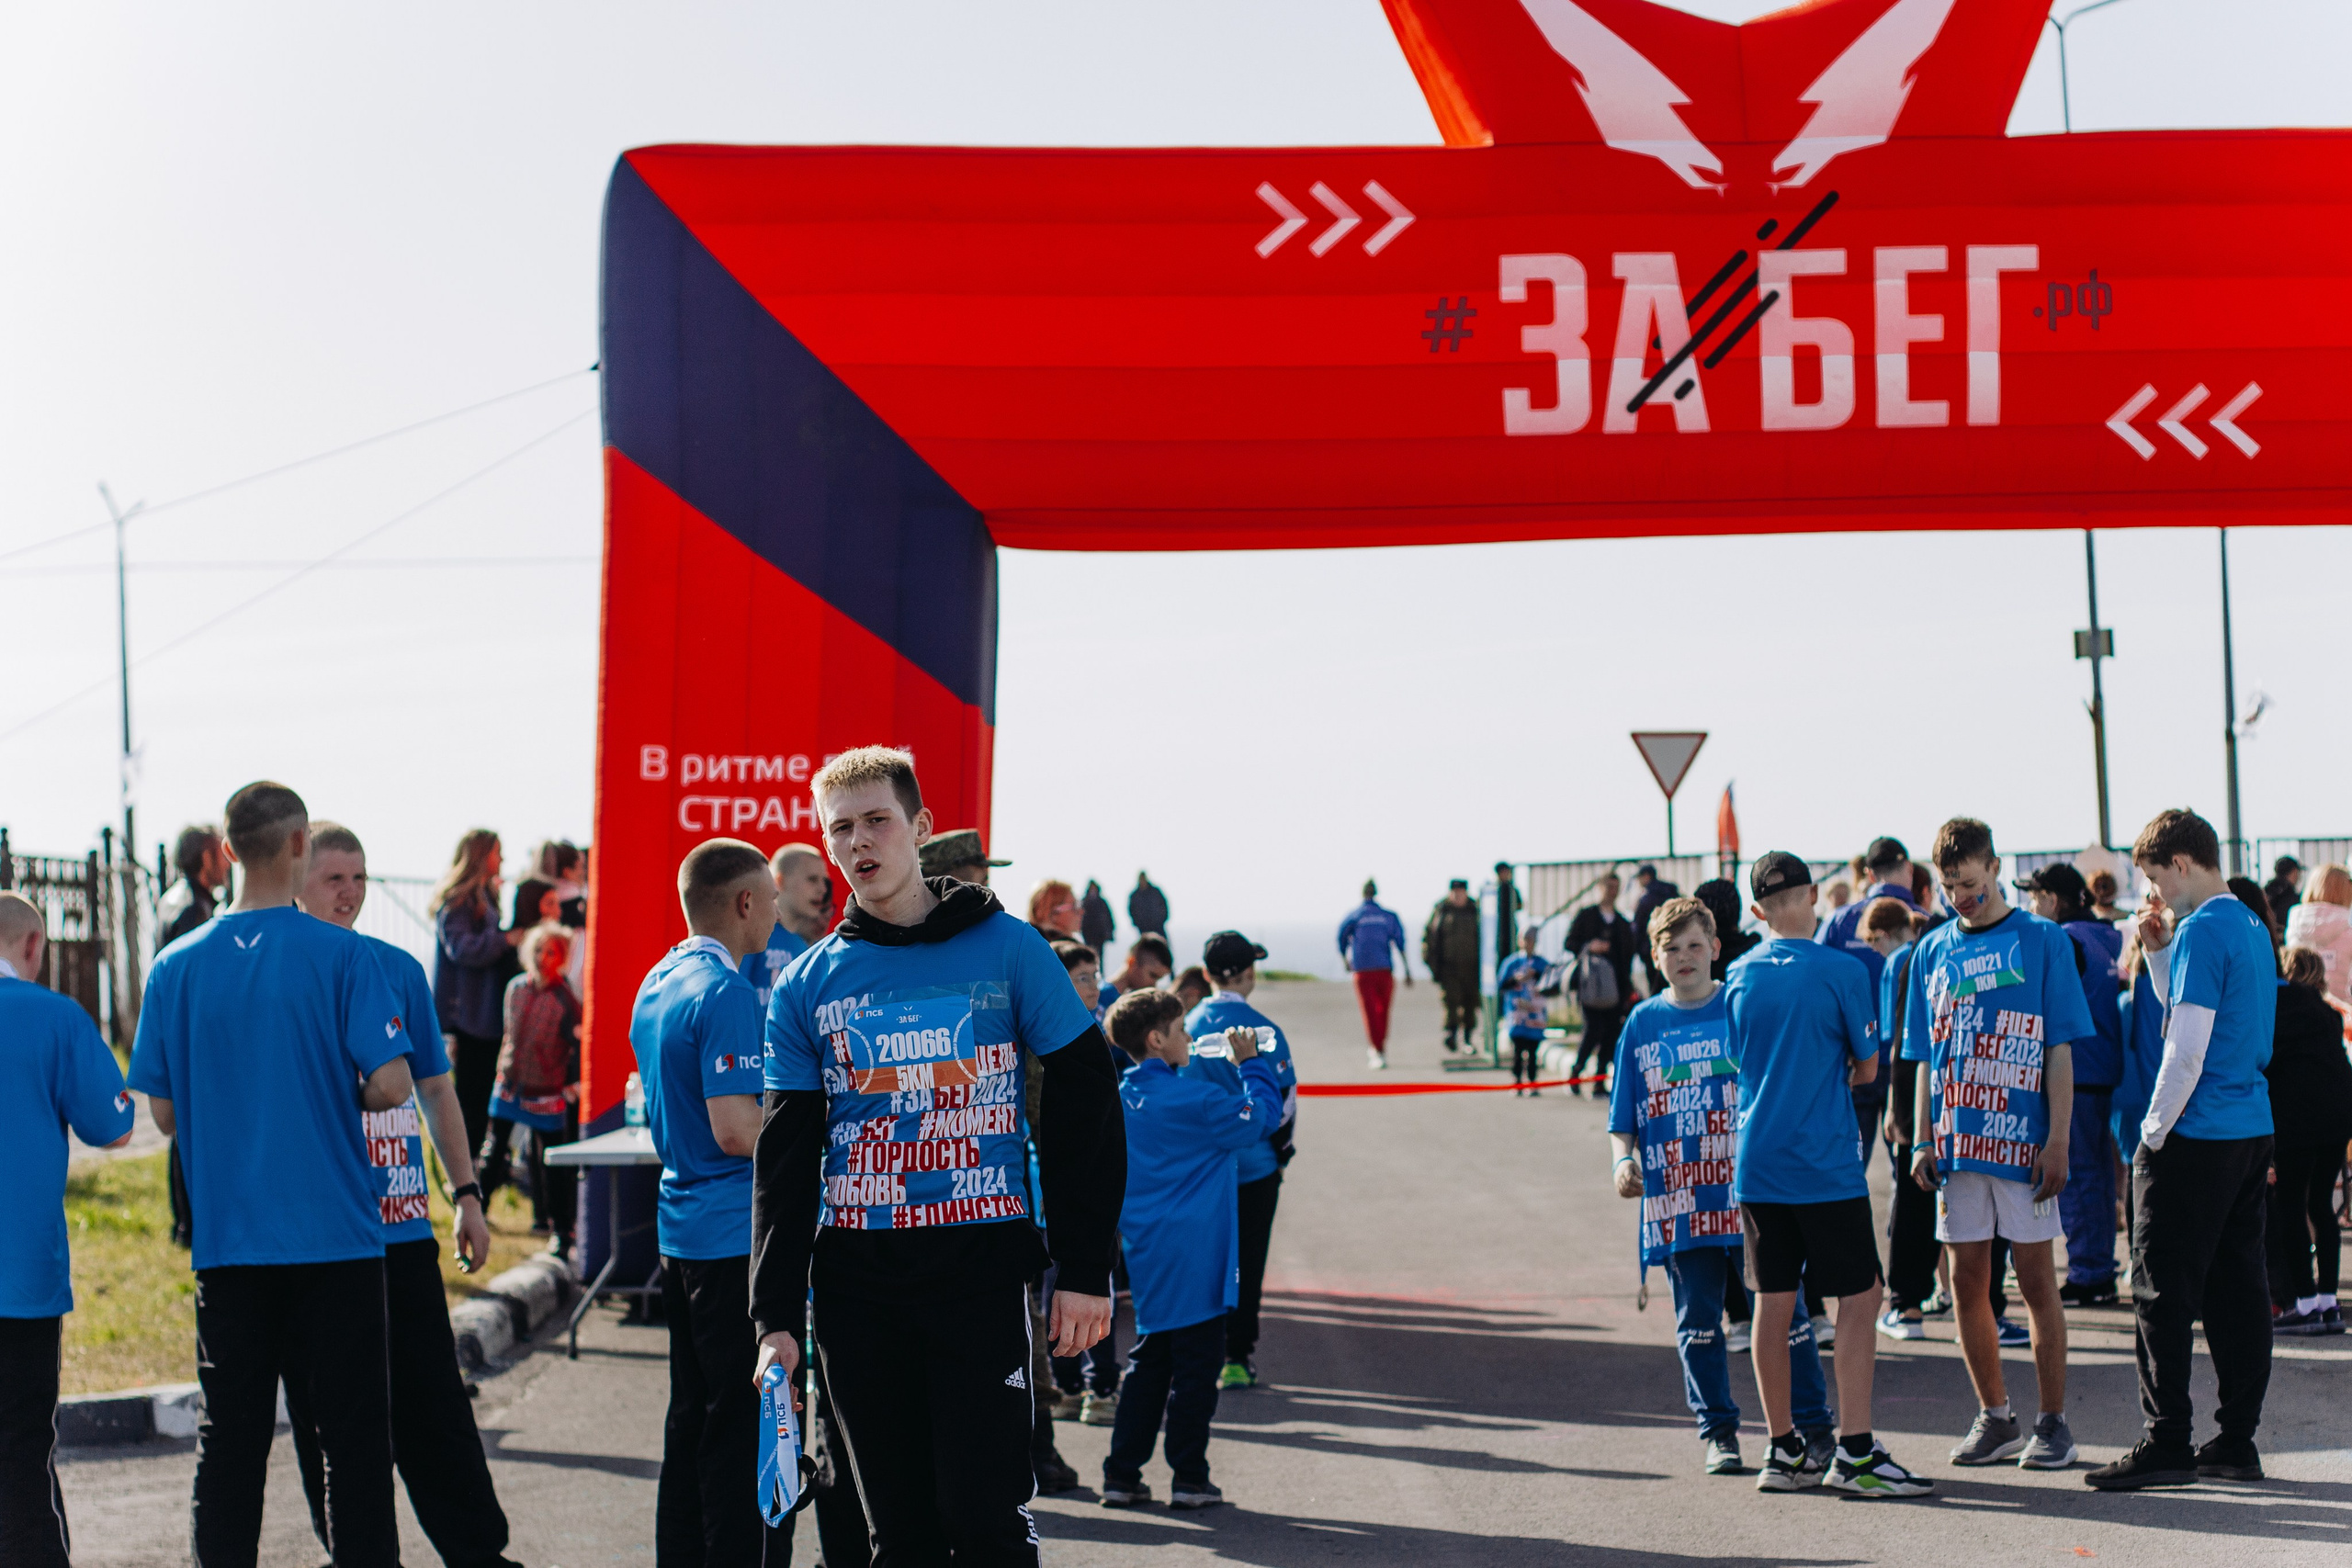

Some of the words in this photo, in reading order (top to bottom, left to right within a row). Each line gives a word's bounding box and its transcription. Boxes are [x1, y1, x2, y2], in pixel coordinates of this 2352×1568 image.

[639, 745, 669, 781] В
[681, 753, 810, 787] ритме
[678, 795, 820, 831] СТРАН
[1962, 952, 2002, 977] 10021
[865, 1010, 884, 1018] ПСБ
[1996, 1010, 2044, 1041] #ЦЕЛ
[876, 1028, 952, 1063] 20066
[975, 1042, 1018, 1077] ЦЕЛЬ
[1634, 1042, 1662, 1072] 202
[1677, 1039, 1721, 1062] 10026
[739, 1055, 762, 1069] ПС
[918, 1103, 1017, 1140] #МОМЕНТ
[1982, 1111, 2029, 1141] 2024
[847, 1137, 980, 1174] #ГОРДОСТЬ
[387, 1166, 424, 1196] 2024
[952, 1165, 1009, 1200] 2024
[1004, 1378, 1025, 1390] adida
[776, 1403, 787, 1426] ПСБ
